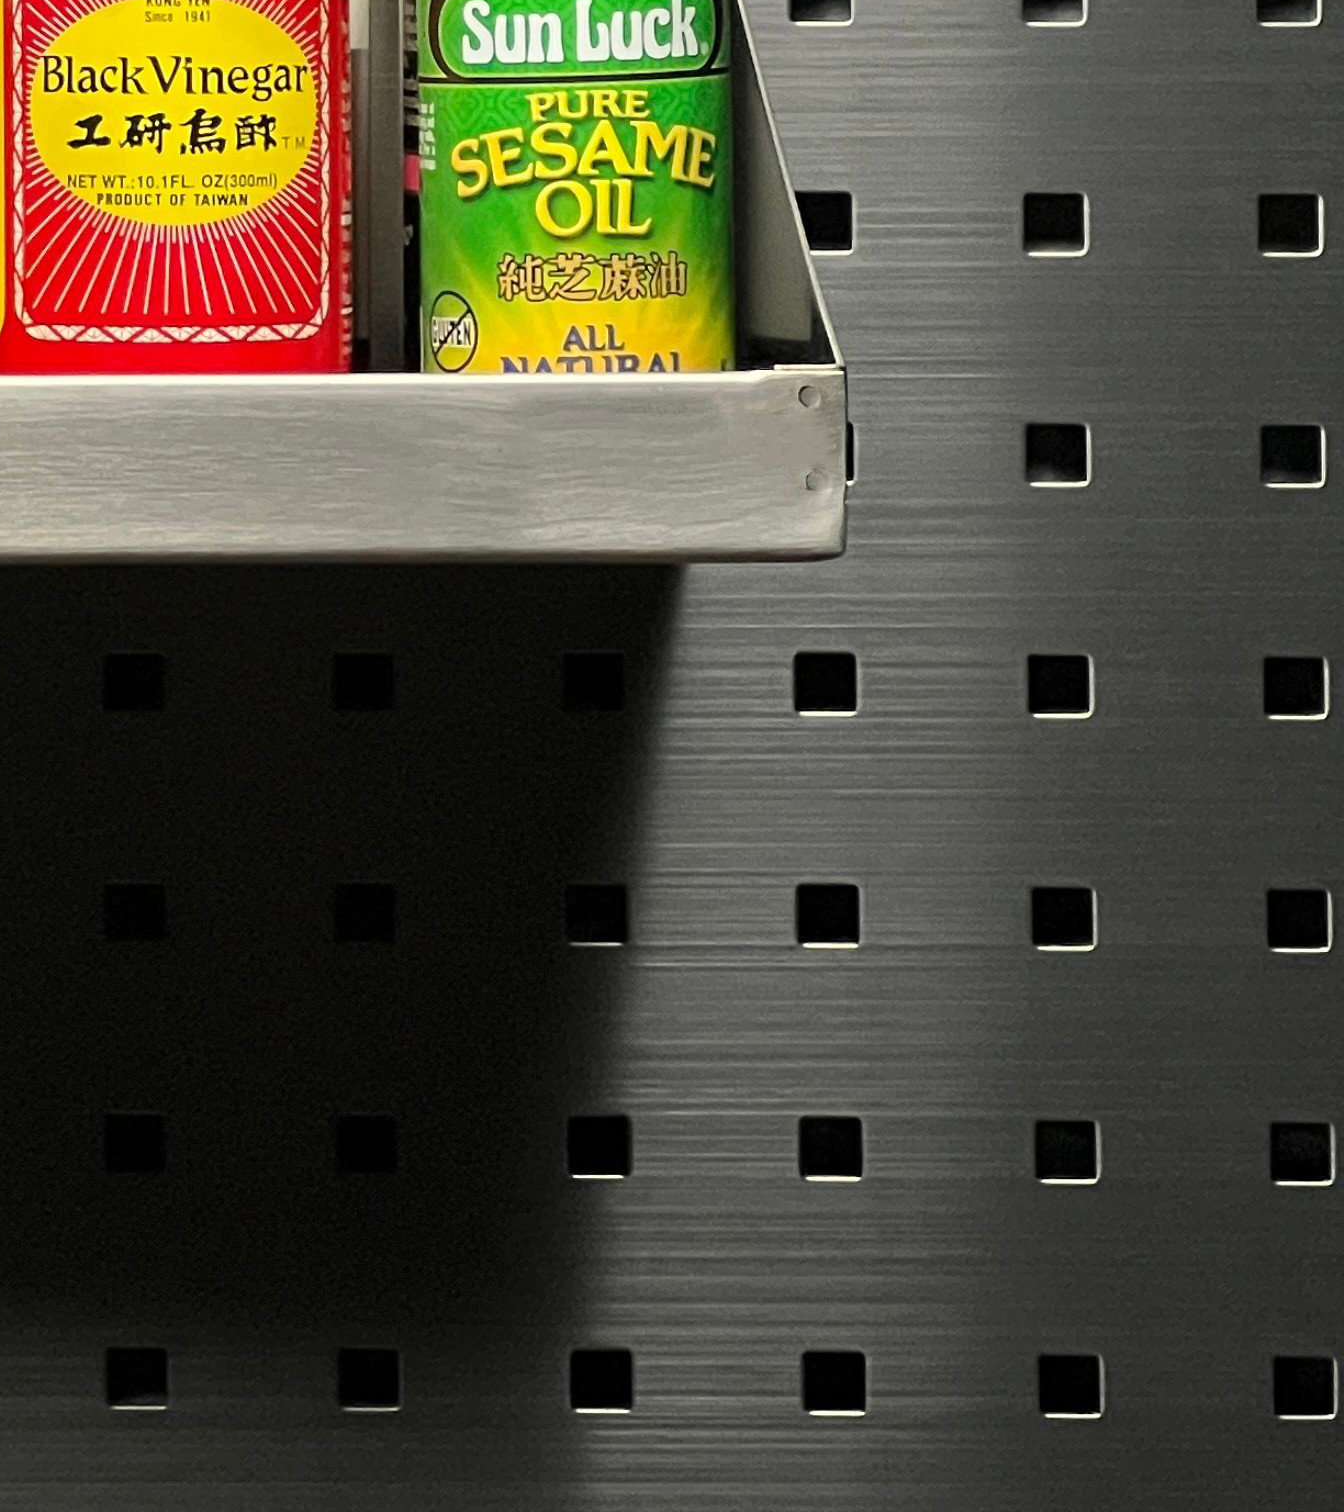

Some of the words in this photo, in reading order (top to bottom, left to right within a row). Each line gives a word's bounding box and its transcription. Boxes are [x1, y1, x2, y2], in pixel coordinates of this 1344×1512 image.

[184, 10, 211, 23] 1941
[461, 0, 564, 65] Sun
[40, 55, 148, 95] Black
[146, 55, 308, 102] Vinegar
[525, 89, 650, 122] PURE
[451, 119, 717, 199] SESAME
[66, 174, 97, 190] NET
[96, 193, 162, 206] PRODUCT
[169, 193, 187, 206] OF
[194, 193, 249, 206] TAIWAN
[535, 178, 652, 239] OIL
[563, 324, 625, 351] ALL
